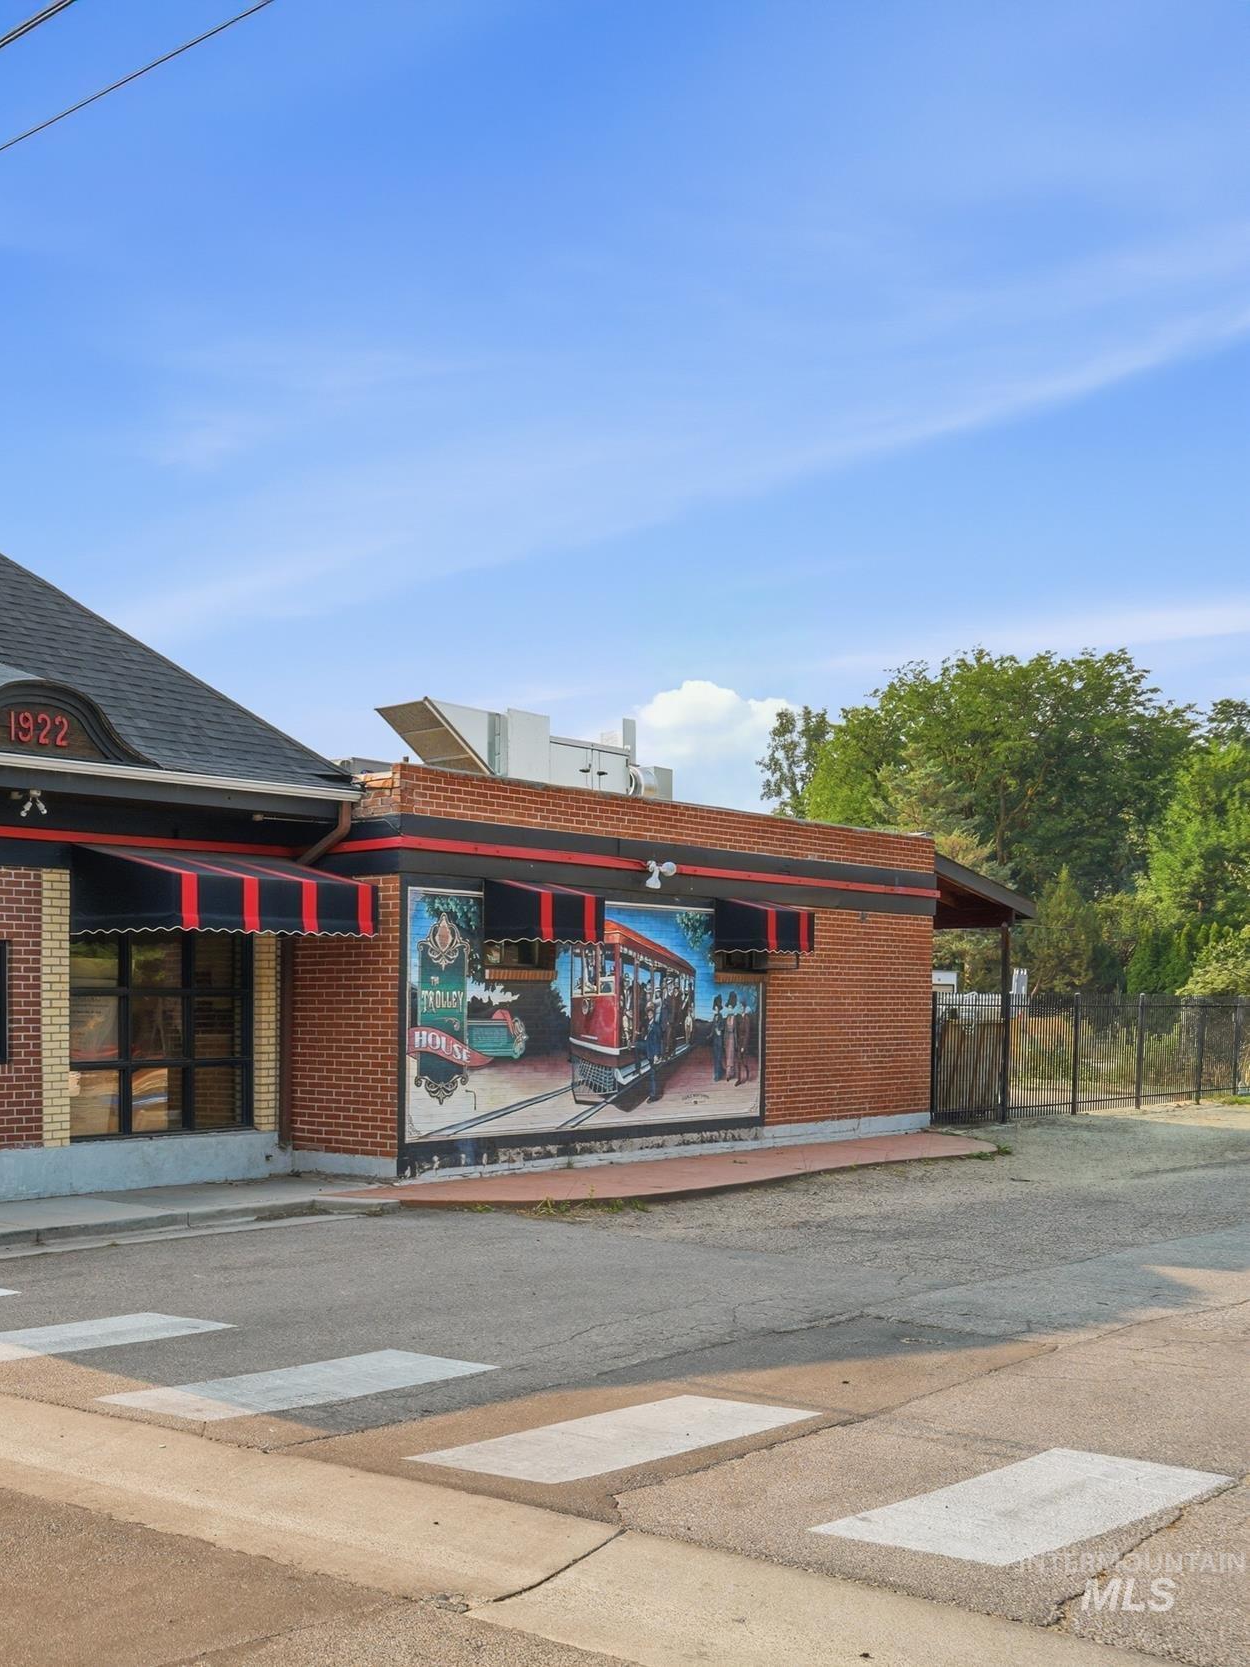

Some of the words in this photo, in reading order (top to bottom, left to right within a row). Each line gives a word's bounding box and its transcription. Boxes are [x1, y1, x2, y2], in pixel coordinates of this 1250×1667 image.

[10, 711, 69, 747] 1922
[421, 990, 464, 1014] TROLLEY
[414, 1031, 471, 1061] HOUSE
